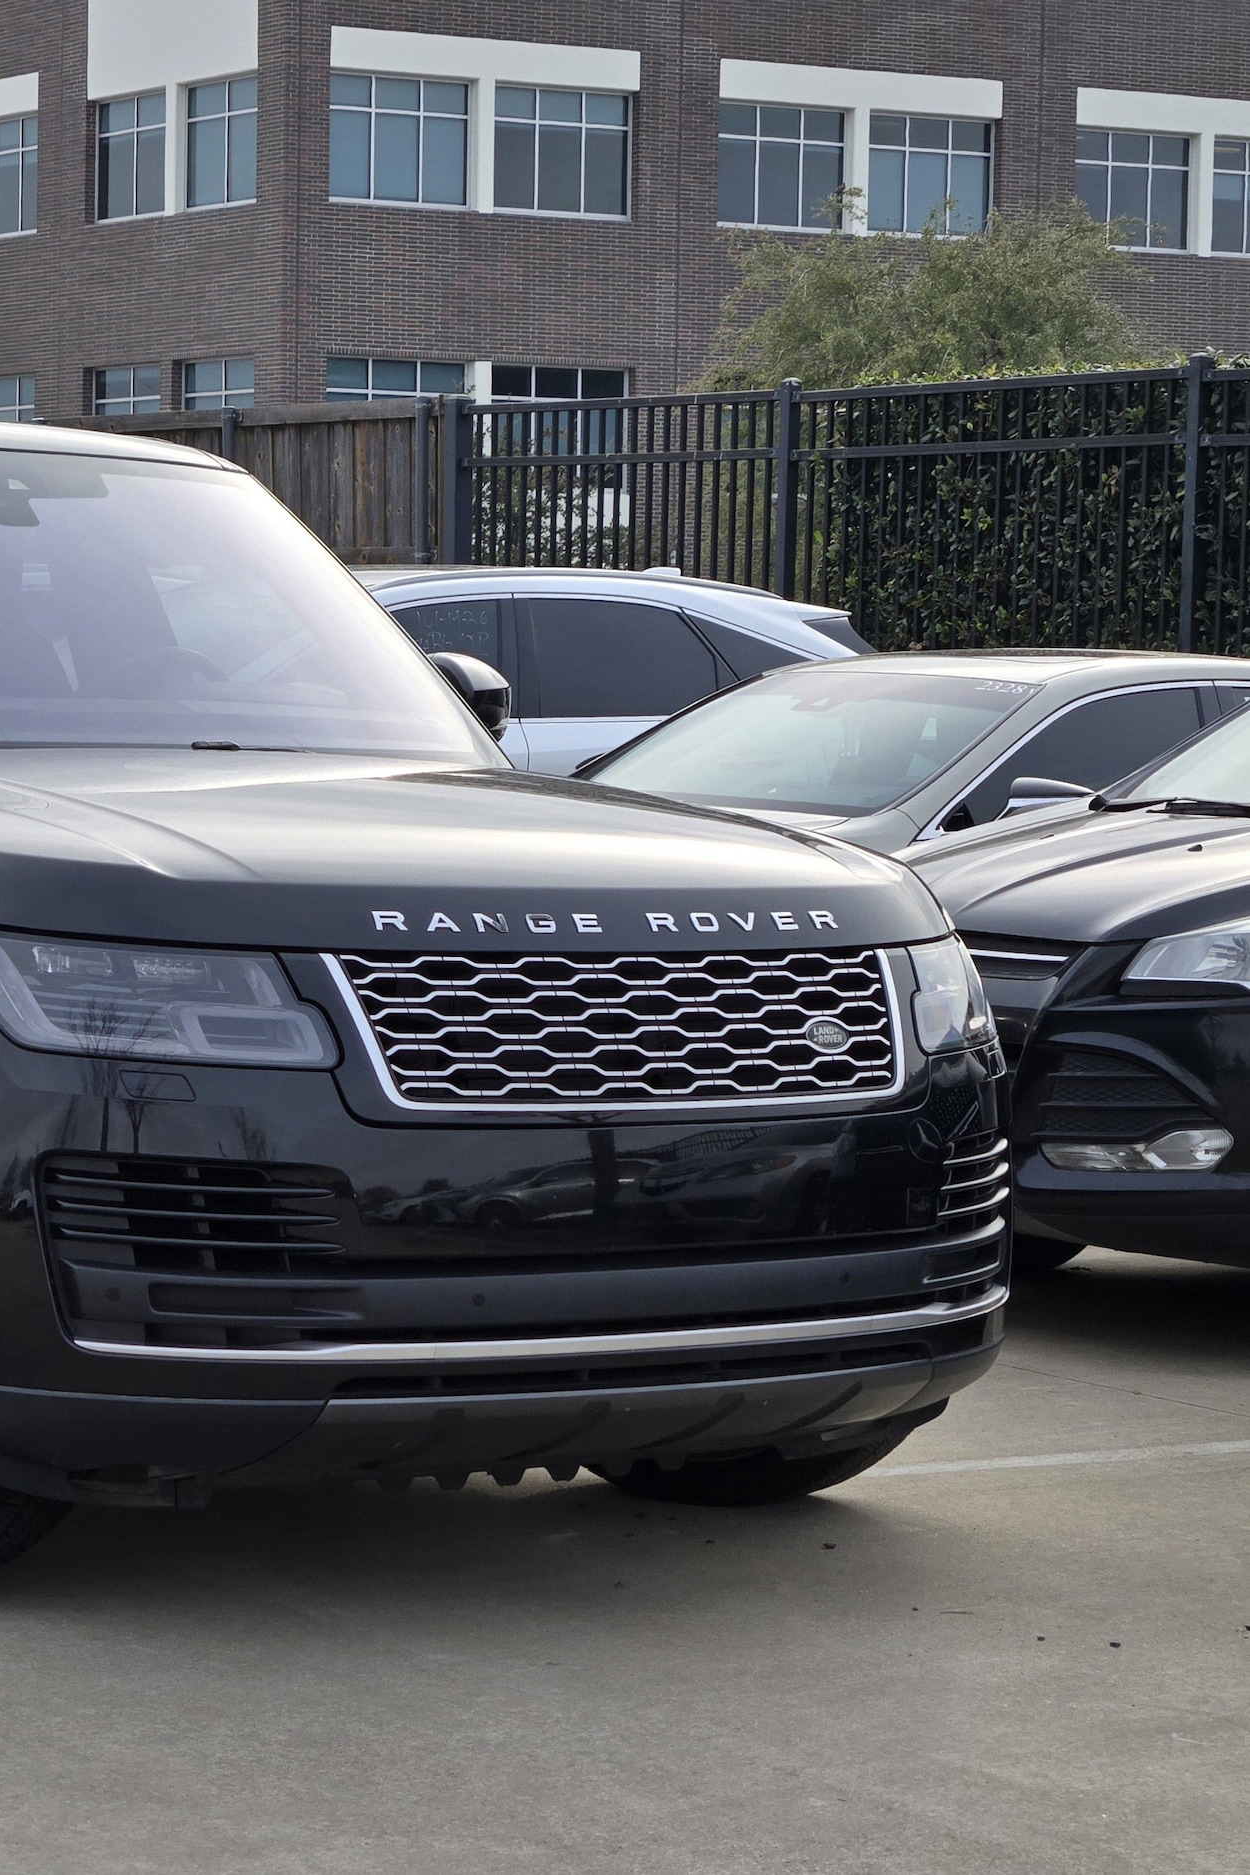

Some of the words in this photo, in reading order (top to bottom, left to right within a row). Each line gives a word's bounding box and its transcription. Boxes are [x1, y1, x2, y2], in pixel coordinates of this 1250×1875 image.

[371, 910, 603, 934] RANGE
[645, 910, 839, 932] ROVER
[813, 1026, 835, 1036] LAND
[818, 1034, 843, 1044] ROVER
